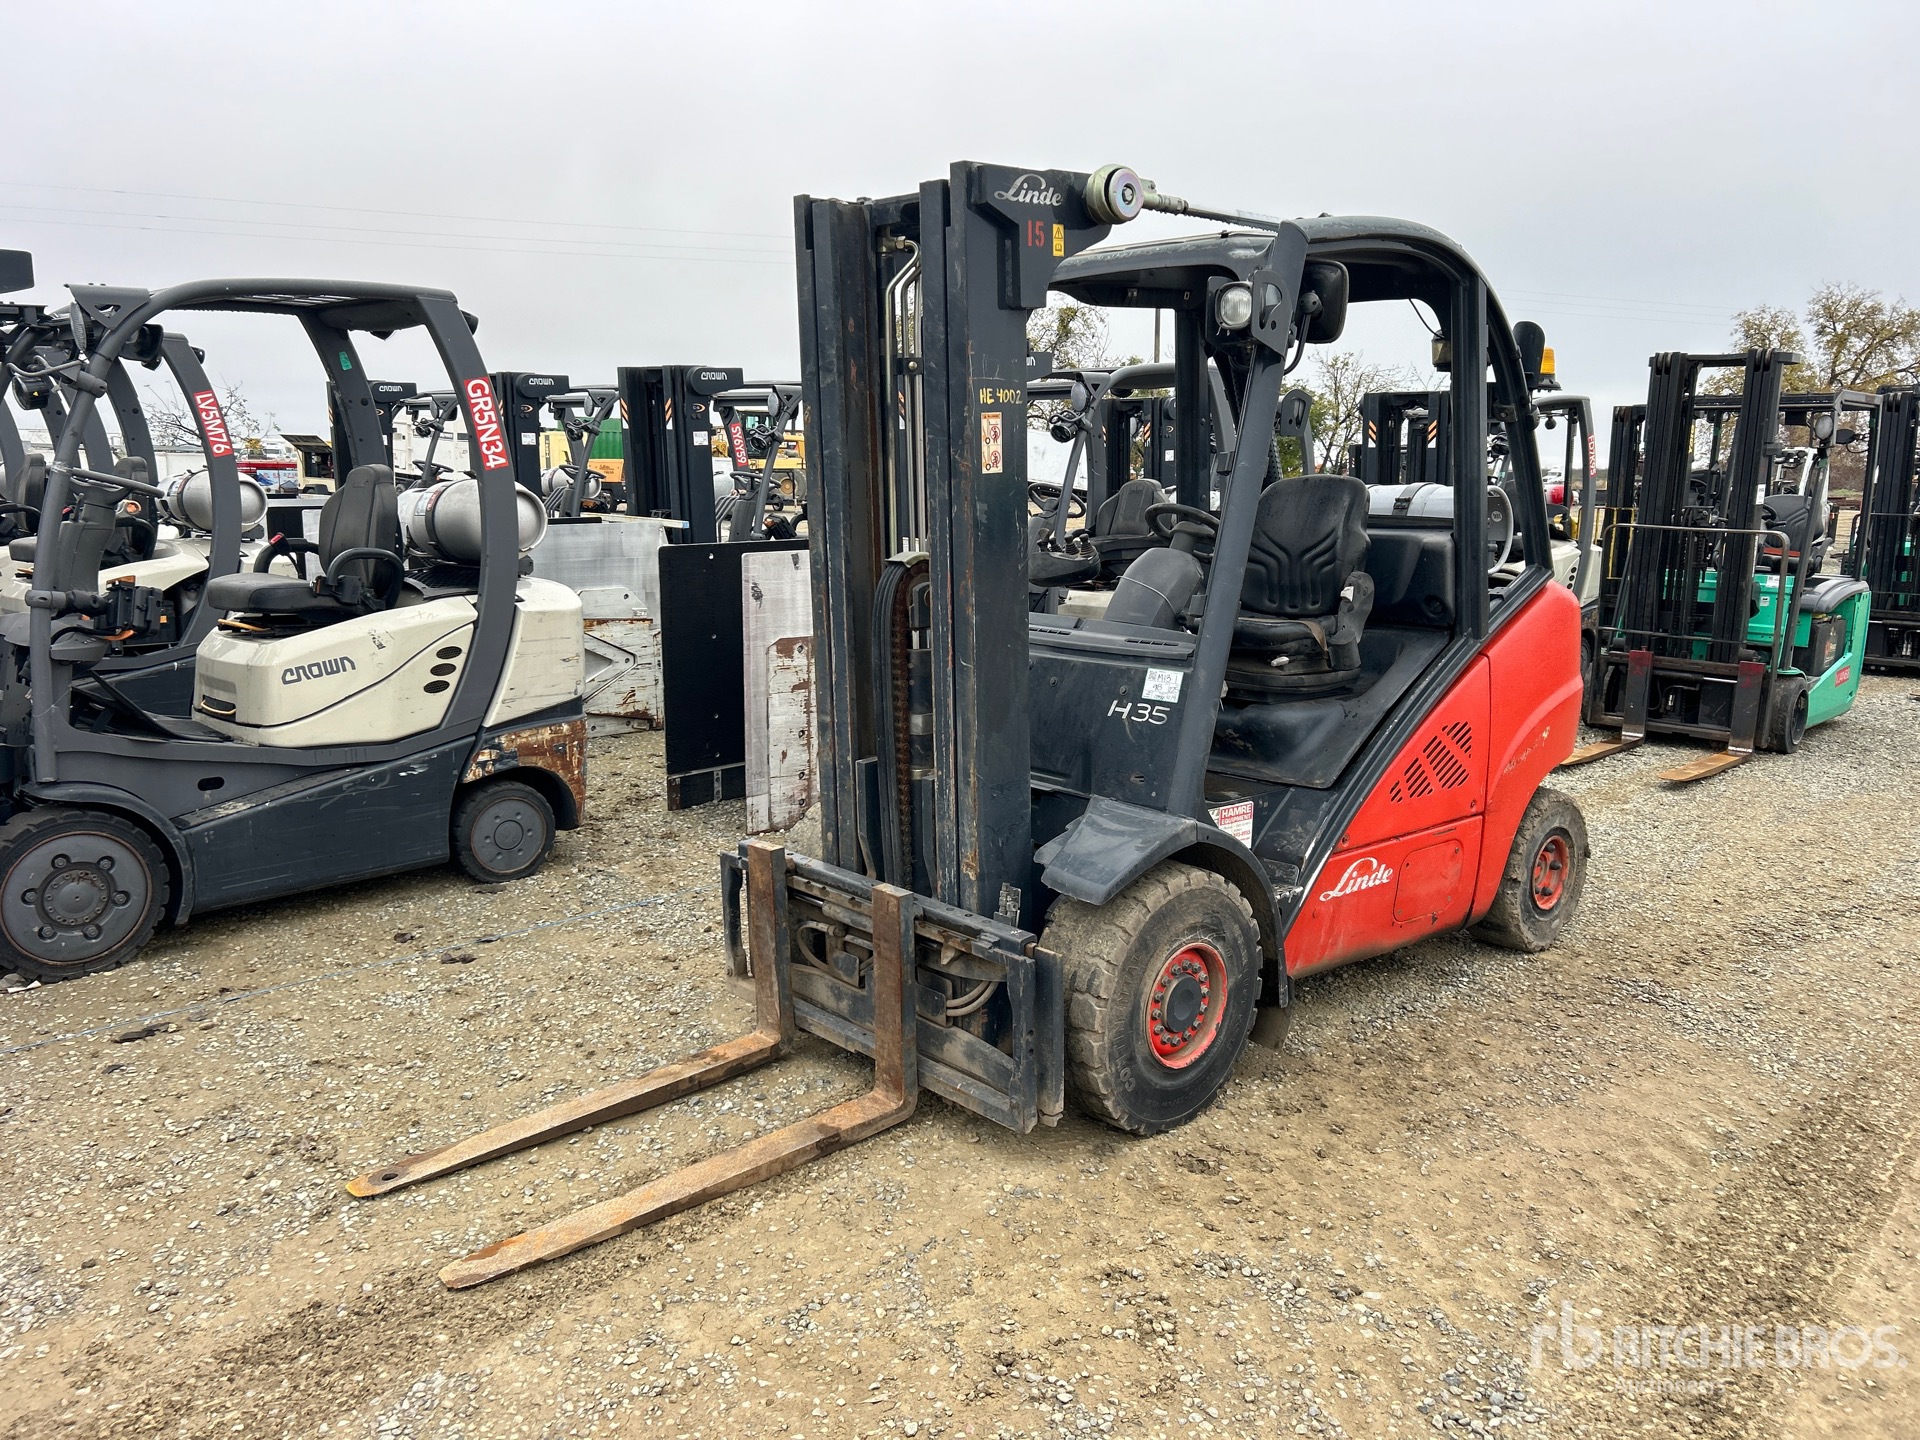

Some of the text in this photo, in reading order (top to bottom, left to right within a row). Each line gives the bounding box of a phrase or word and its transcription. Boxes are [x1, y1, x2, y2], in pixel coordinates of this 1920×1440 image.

[994, 173, 1062, 207] Linde
[1027, 220, 1045, 247] 15
[529, 378, 555, 386] CROWN
[701, 371, 728, 381] CROWN
[980, 388, 1023, 405] HE 4002
[195, 393, 231, 454] LV5M76
[467, 378, 506, 469] GR5N34
[731, 426, 747, 464] SY6Y59
[1588, 434, 1597, 476] FD7K95
[281, 656, 356, 685] CROWN
[1221, 814, 1252, 825] EQUIPMENT
[1222, 804, 1252, 819] HAMRE
[1319, 857, 1394, 902] Linde
